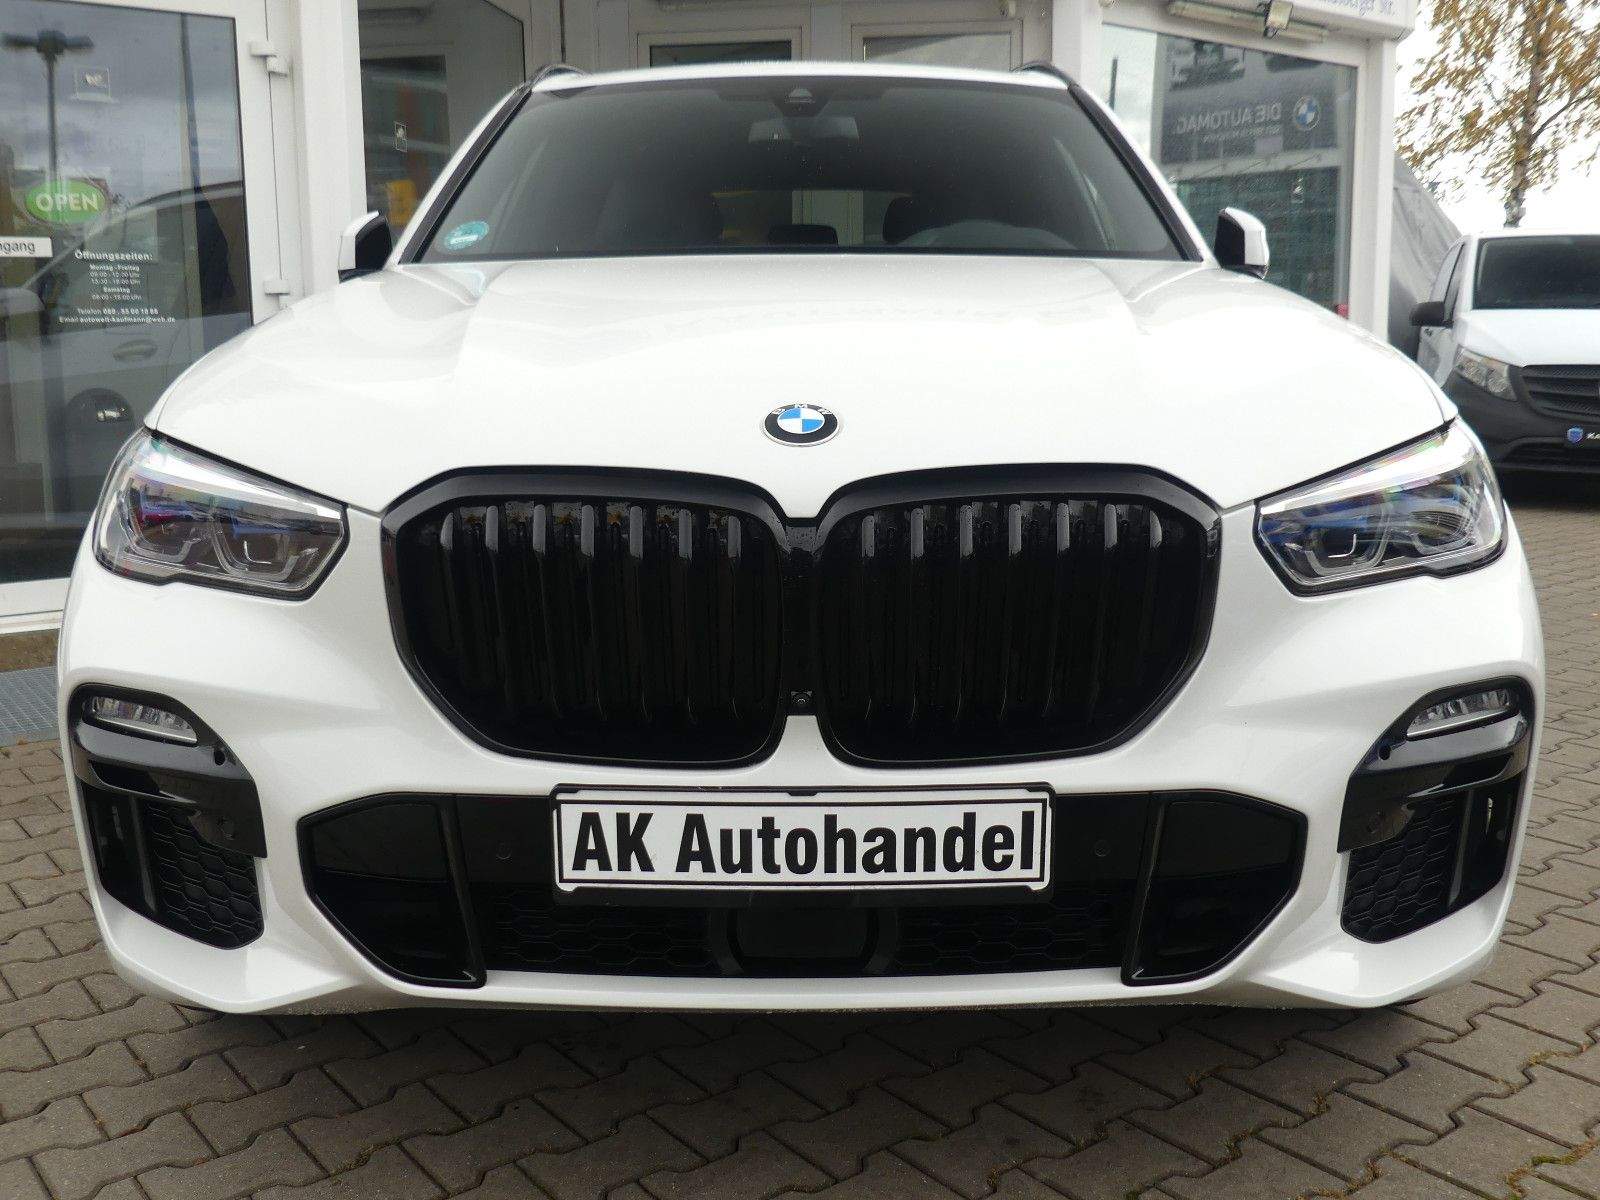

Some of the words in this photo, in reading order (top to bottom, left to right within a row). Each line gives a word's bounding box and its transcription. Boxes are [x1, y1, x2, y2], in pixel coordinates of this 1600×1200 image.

[35, 191, 99, 212] OPEN
[571, 811, 656, 873] AK
[675, 810, 1036, 874] Autohandel
